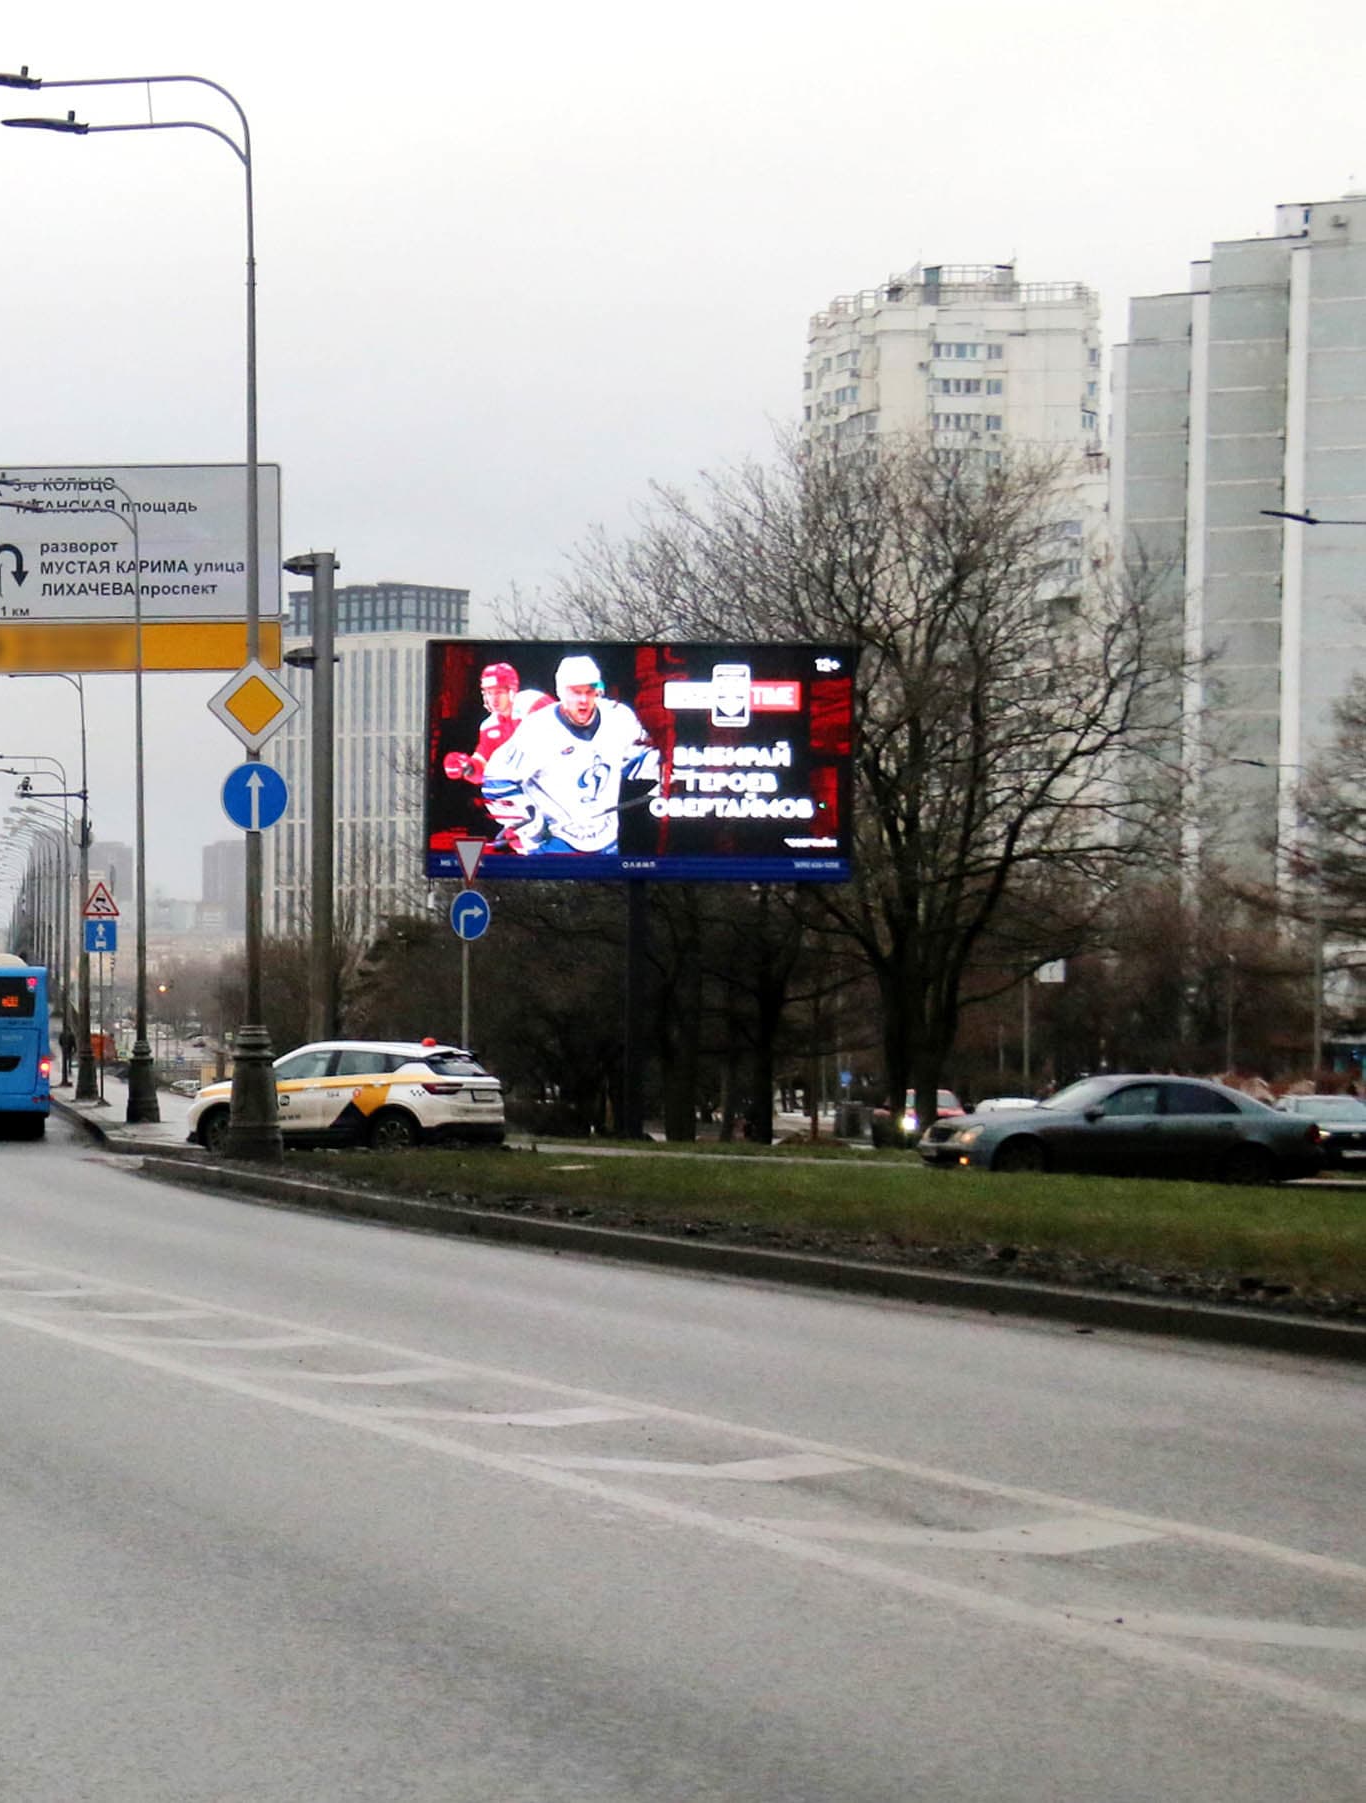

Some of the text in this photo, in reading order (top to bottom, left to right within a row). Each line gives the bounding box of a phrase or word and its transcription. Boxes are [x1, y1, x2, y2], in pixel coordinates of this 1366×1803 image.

[42, 477, 115, 493] КОЛЬЦО
[122, 500, 198, 514] площадь
[40, 542, 118, 556] разворот
[40, 560, 245, 576] МУСТАЯ КАРИМА улица
[41, 582, 218, 597] ЛИХАЧЕВА проспект
[0, 606, 30, 617] 1 км
[673, 741, 792, 767] ВЫБИРАЙ
[649, 792, 814, 818] ОВЕРТАЙМОВ
